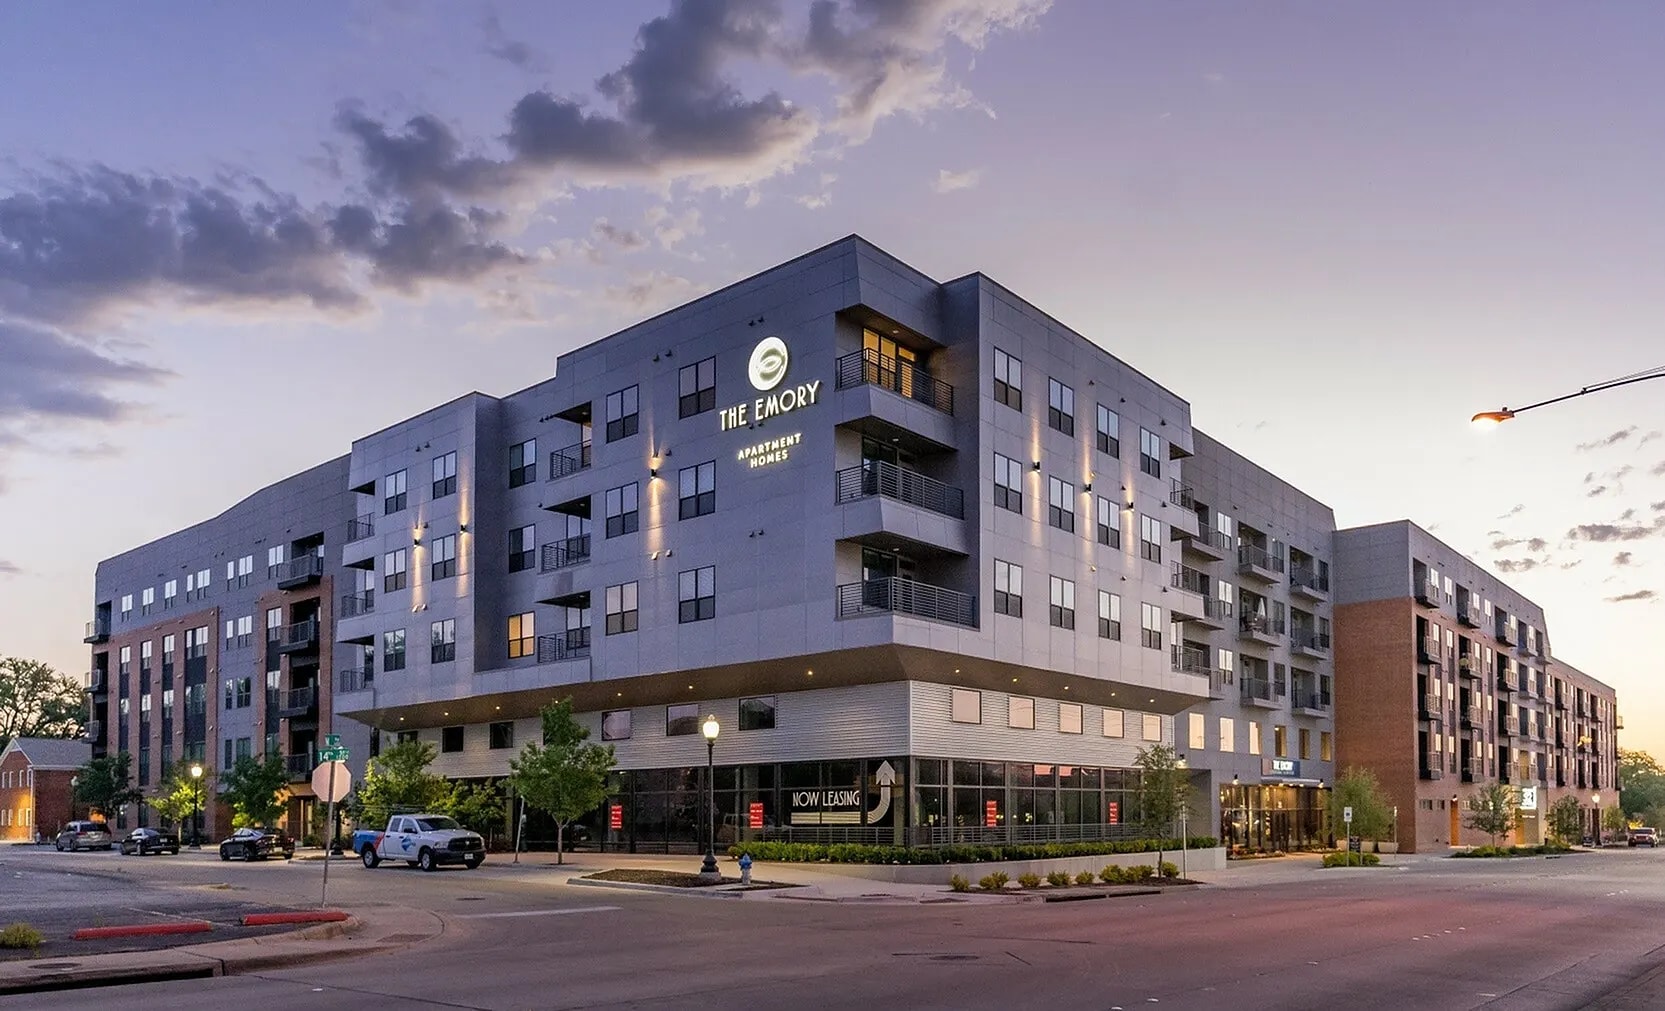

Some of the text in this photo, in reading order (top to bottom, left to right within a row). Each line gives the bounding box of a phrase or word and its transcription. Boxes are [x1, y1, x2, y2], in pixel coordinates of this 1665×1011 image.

[719, 379, 820, 432] THE EMORY
[737, 432, 802, 461] APARTMENT
[750, 449, 789, 469] HOMES
[792, 790, 860, 807] NOW LEASING
